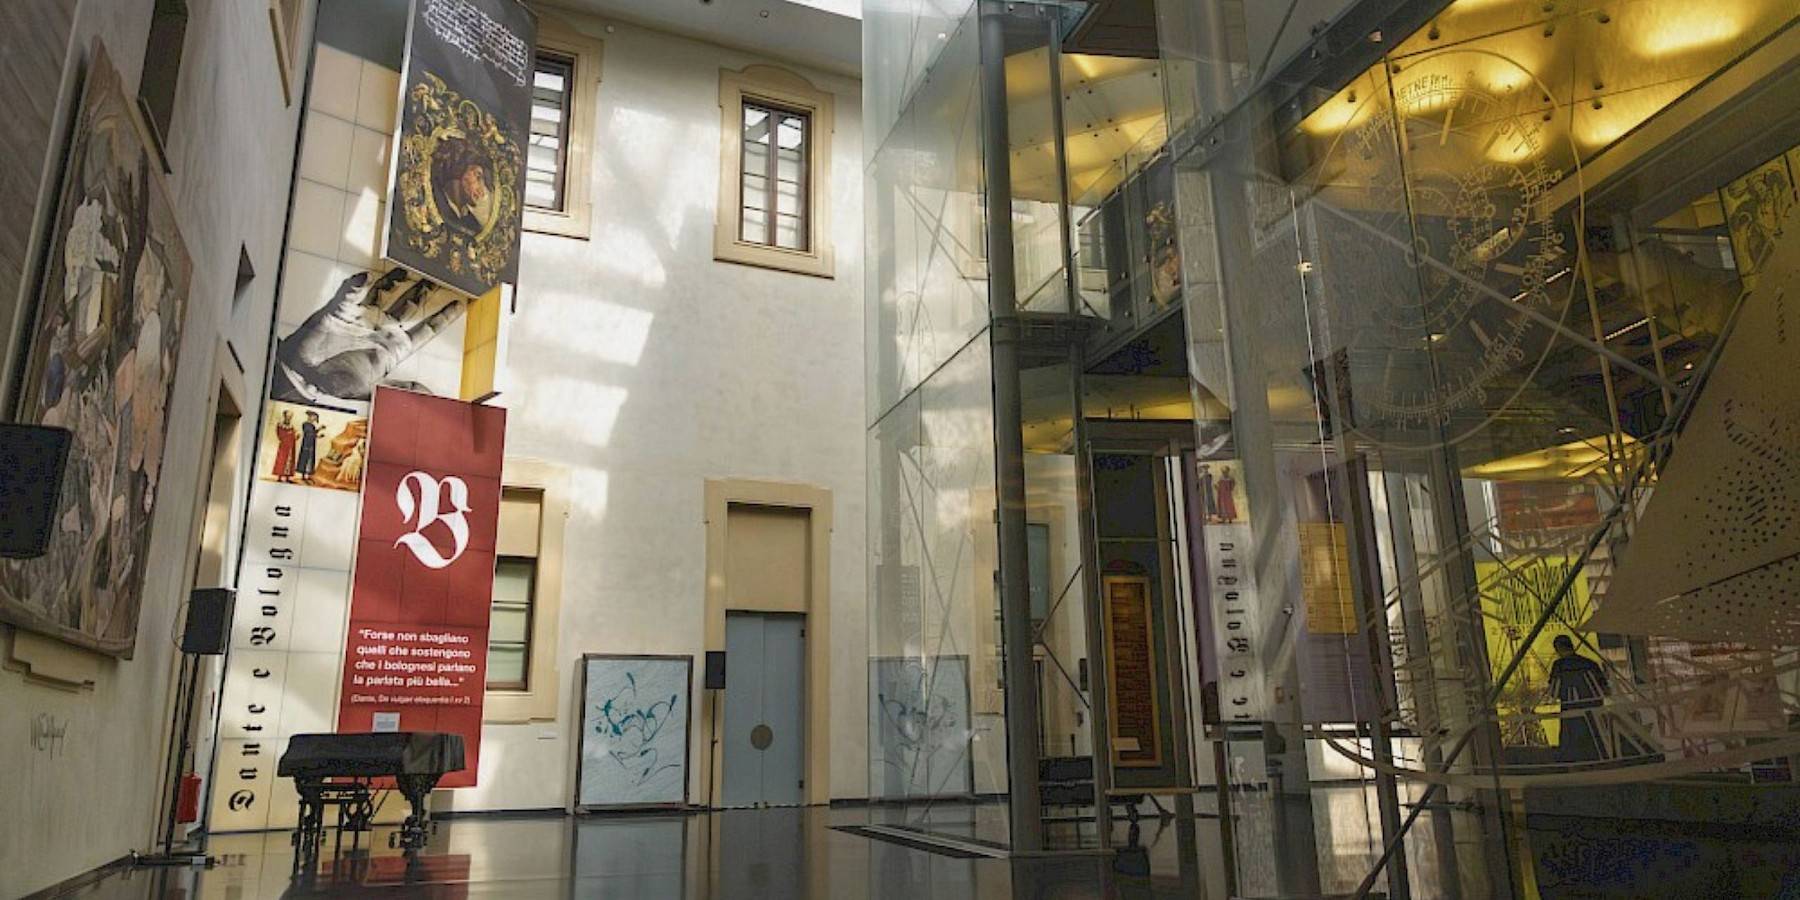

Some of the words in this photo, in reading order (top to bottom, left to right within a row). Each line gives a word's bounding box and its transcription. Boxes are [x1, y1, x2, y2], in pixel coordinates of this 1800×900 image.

[393, 470, 472, 569] B
[250, 505, 293, 645] Bologna
[397, 631, 418, 642] non
[419, 632, 469, 644] sbagliano
[356, 645, 386, 656] quelli
[388, 646, 408, 656] che
[411, 648, 471, 659] sostengono
[252, 668, 271, 679] e
[355, 660, 376, 670] che
[378, 660, 382, 669] i
[384, 660, 436, 673] bolognesi
[437, 662, 476, 673] parlano
[353, 674, 363, 684] la
[366, 676, 404, 687] parlata
[406, 677, 424, 688] più
[228, 704, 265, 812] Dante
